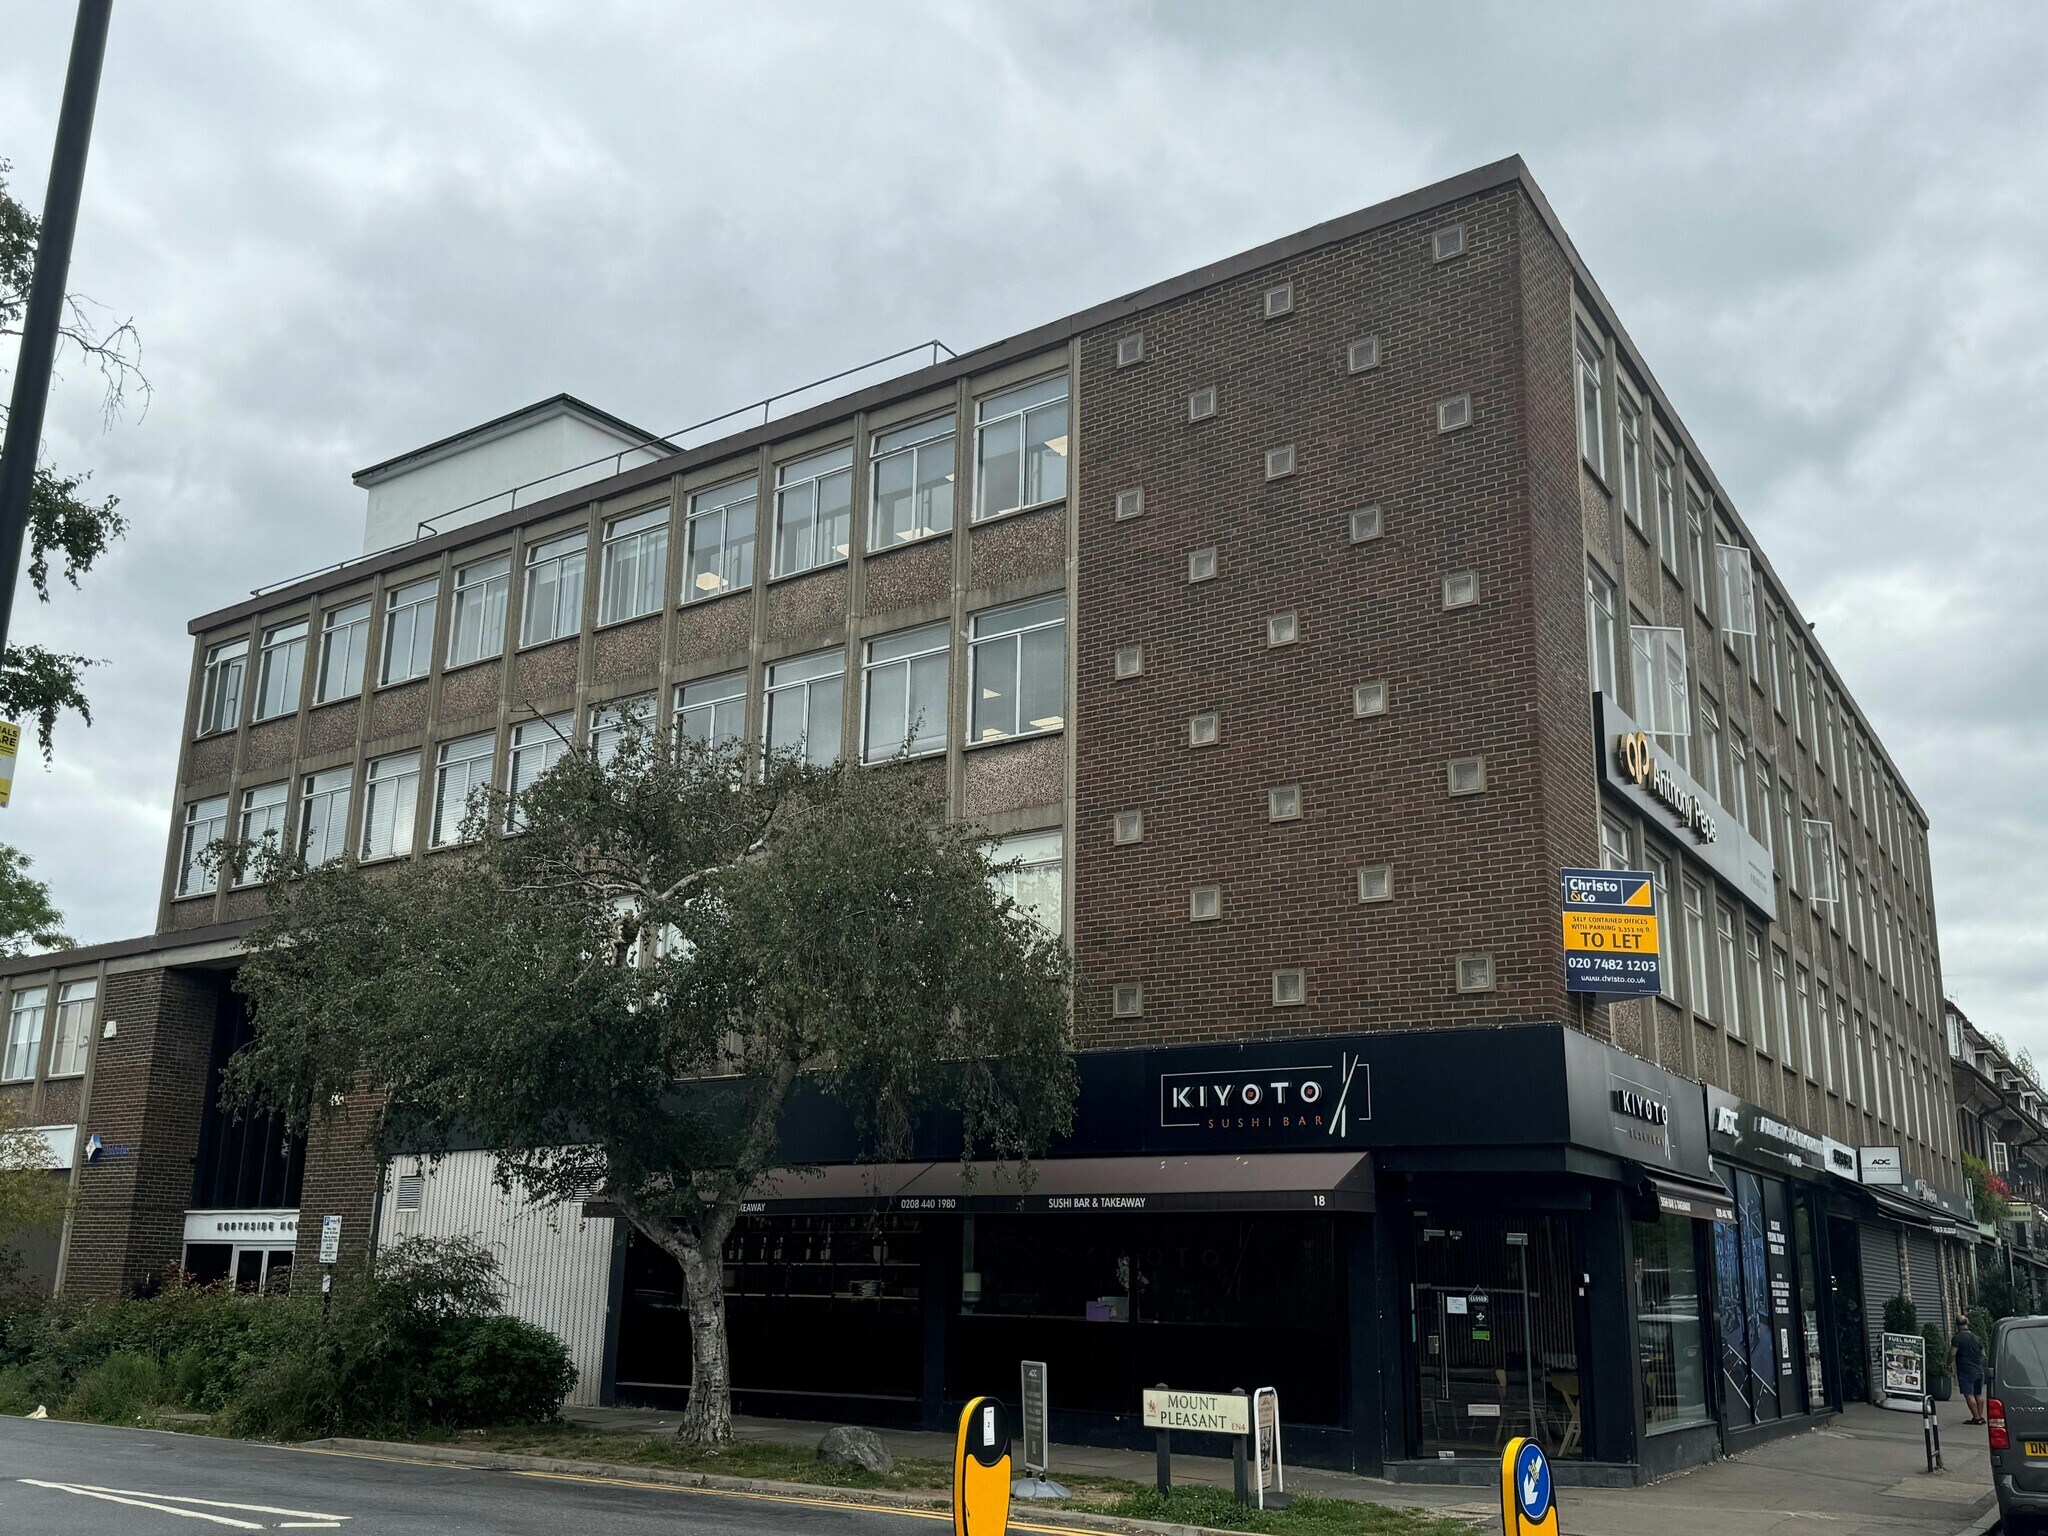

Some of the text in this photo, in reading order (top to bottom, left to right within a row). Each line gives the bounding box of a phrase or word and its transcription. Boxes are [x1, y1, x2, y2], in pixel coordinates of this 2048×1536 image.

[1653, 758, 1717, 843] Anthony Pepe
[1569, 879, 1618, 892] Christo
[1580, 932, 1642, 949] TO LET
[1568, 957, 1657, 972] 020 7482 1203
[1581, 974, 1646, 984] www.christo.co.uk
[1172, 1081, 1322, 1108] KIYOTO
[1622, 1090, 1668, 1126] KIYOTO
[901, 1199, 956, 1209] 0208 440 1980
[1048, 1197, 1146, 1208] SUSHI BAR & TAKEAWAY
[1313, 1195, 1326, 1206] 18
[1168, 1395, 1218, 1411] MOUNT
[1160, 1411, 1227, 1429] PLEASANT
[1231, 1422, 1246, 1431] EN4
[2030, 1442, 2048, 1454] DN
